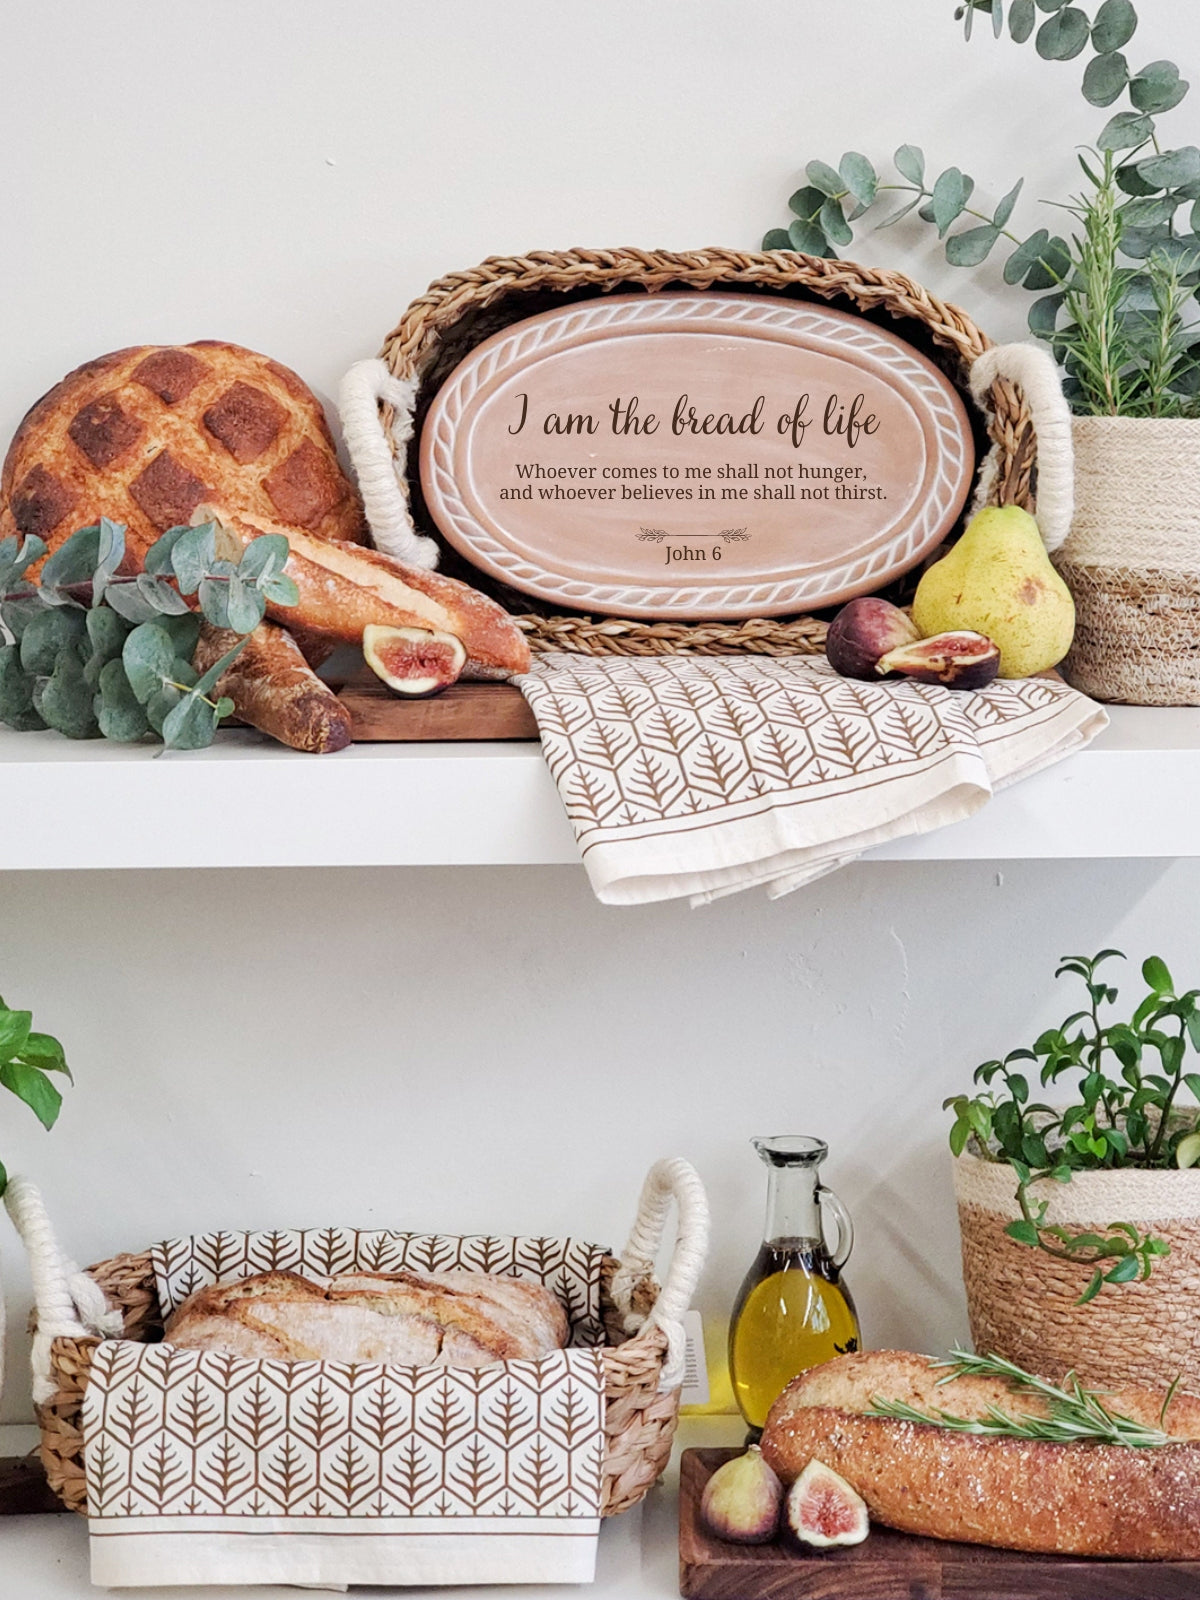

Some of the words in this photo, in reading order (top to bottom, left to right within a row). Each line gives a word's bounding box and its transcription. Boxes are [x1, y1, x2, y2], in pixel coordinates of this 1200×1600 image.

[507, 393, 529, 435] I
[543, 413, 600, 435] am
[608, 396, 661, 436] the
[671, 393, 766, 436] bread
[776, 393, 814, 449] of
[822, 393, 881, 449] life
[515, 463, 598, 479] Whoever
[602, 467, 658, 479] comes
[661, 465, 680, 479] to
[684, 467, 712, 479] me
[717, 463, 760, 479] shall
[763, 465, 794, 479] not
[797, 463, 867, 484] hunger,
[499, 484, 534, 500] and
[537, 484, 617, 500] whoever
[620, 484, 693, 500] believes
[697, 484, 717, 500] in
[720, 488, 749, 500] me
[753, 484, 796, 500] shall
[800, 486, 830, 500] not
[834, 484, 887, 500] thirst.
[664, 545, 707, 566] John
[711, 545, 722, 561] 6
